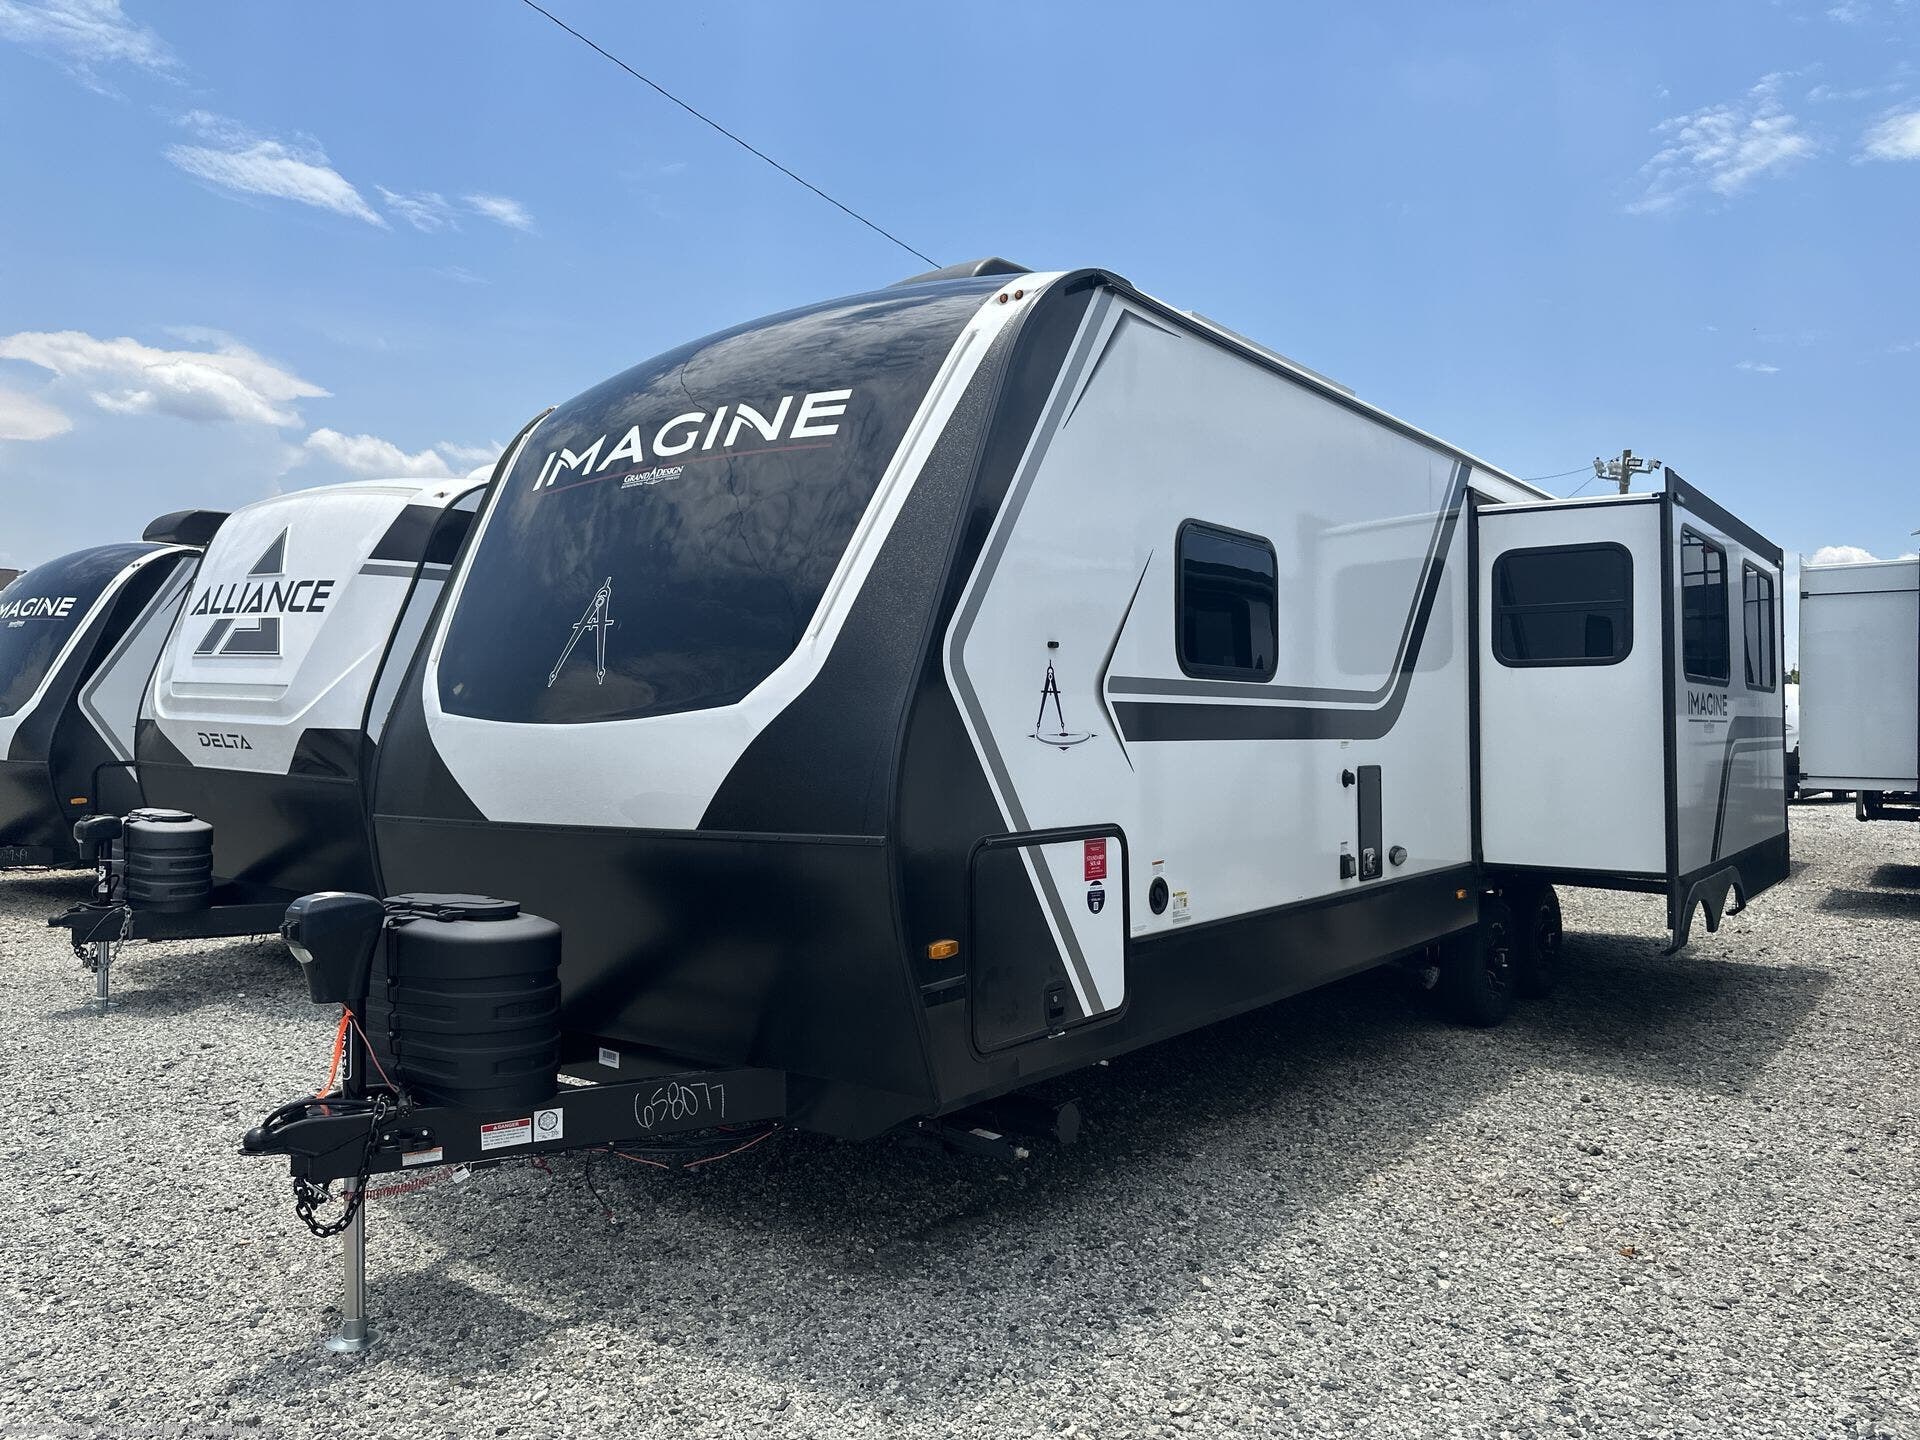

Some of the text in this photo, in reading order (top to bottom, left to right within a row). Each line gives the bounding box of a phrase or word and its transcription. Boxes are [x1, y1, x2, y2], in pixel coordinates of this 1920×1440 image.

[533, 389, 852, 491] IMAGINE
[623, 465, 684, 483] GRAND DESIGN
[190, 580, 335, 616] ALLIANCE
[1688, 690, 1727, 716] IMAGINE
[197, 731, 253, 750] DELTA
[634, 1082, 725, 1130] 658077
[497, 1121, 520, 1130] DANGER
